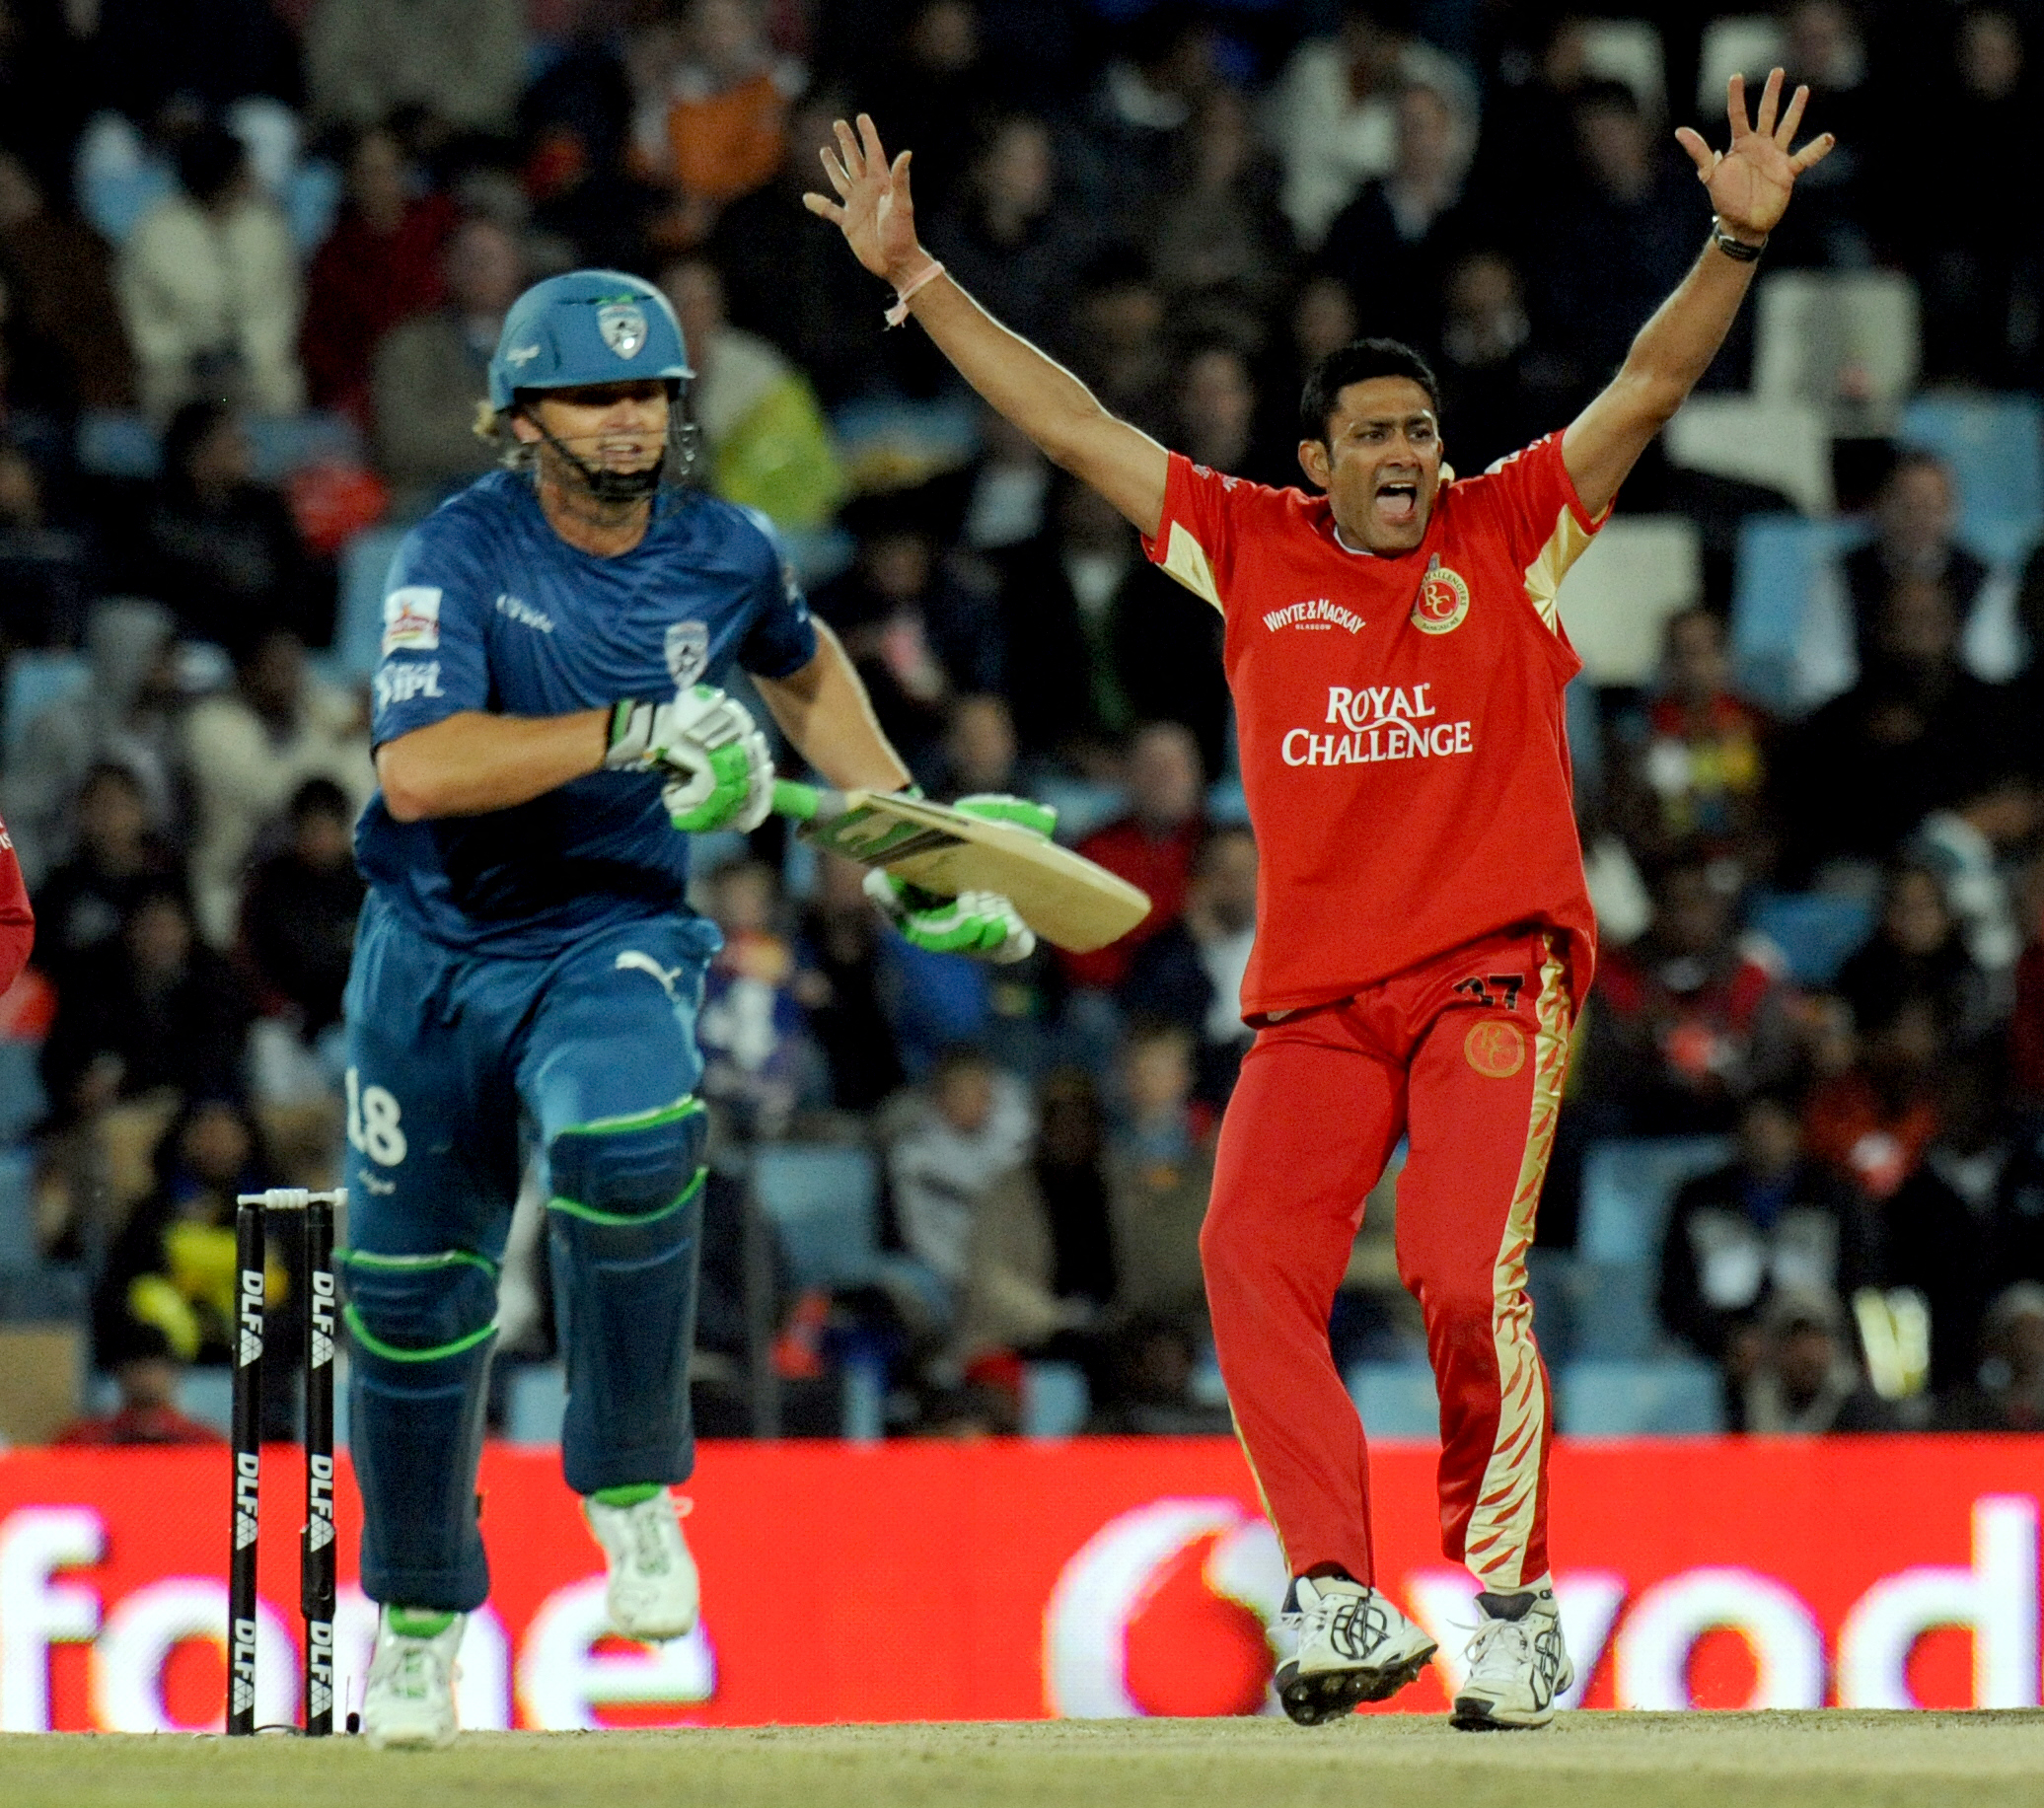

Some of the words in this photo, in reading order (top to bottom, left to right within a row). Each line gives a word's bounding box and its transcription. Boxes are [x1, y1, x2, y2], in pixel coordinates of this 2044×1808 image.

[1325, 684, 1436, 730] ROYAL
[1281, 721, 1474, 766] CHALLENGE
[241, 1269, 263, 1334] DLF
[312, 1270, 334, 1336] DLF
[237, 1452, 259, 1519] DLF
[311, 1453, 333, 1520] DLF
[234, 1618, 256, 1686] DLF
[311, 1621, 333, 1687] DLF
